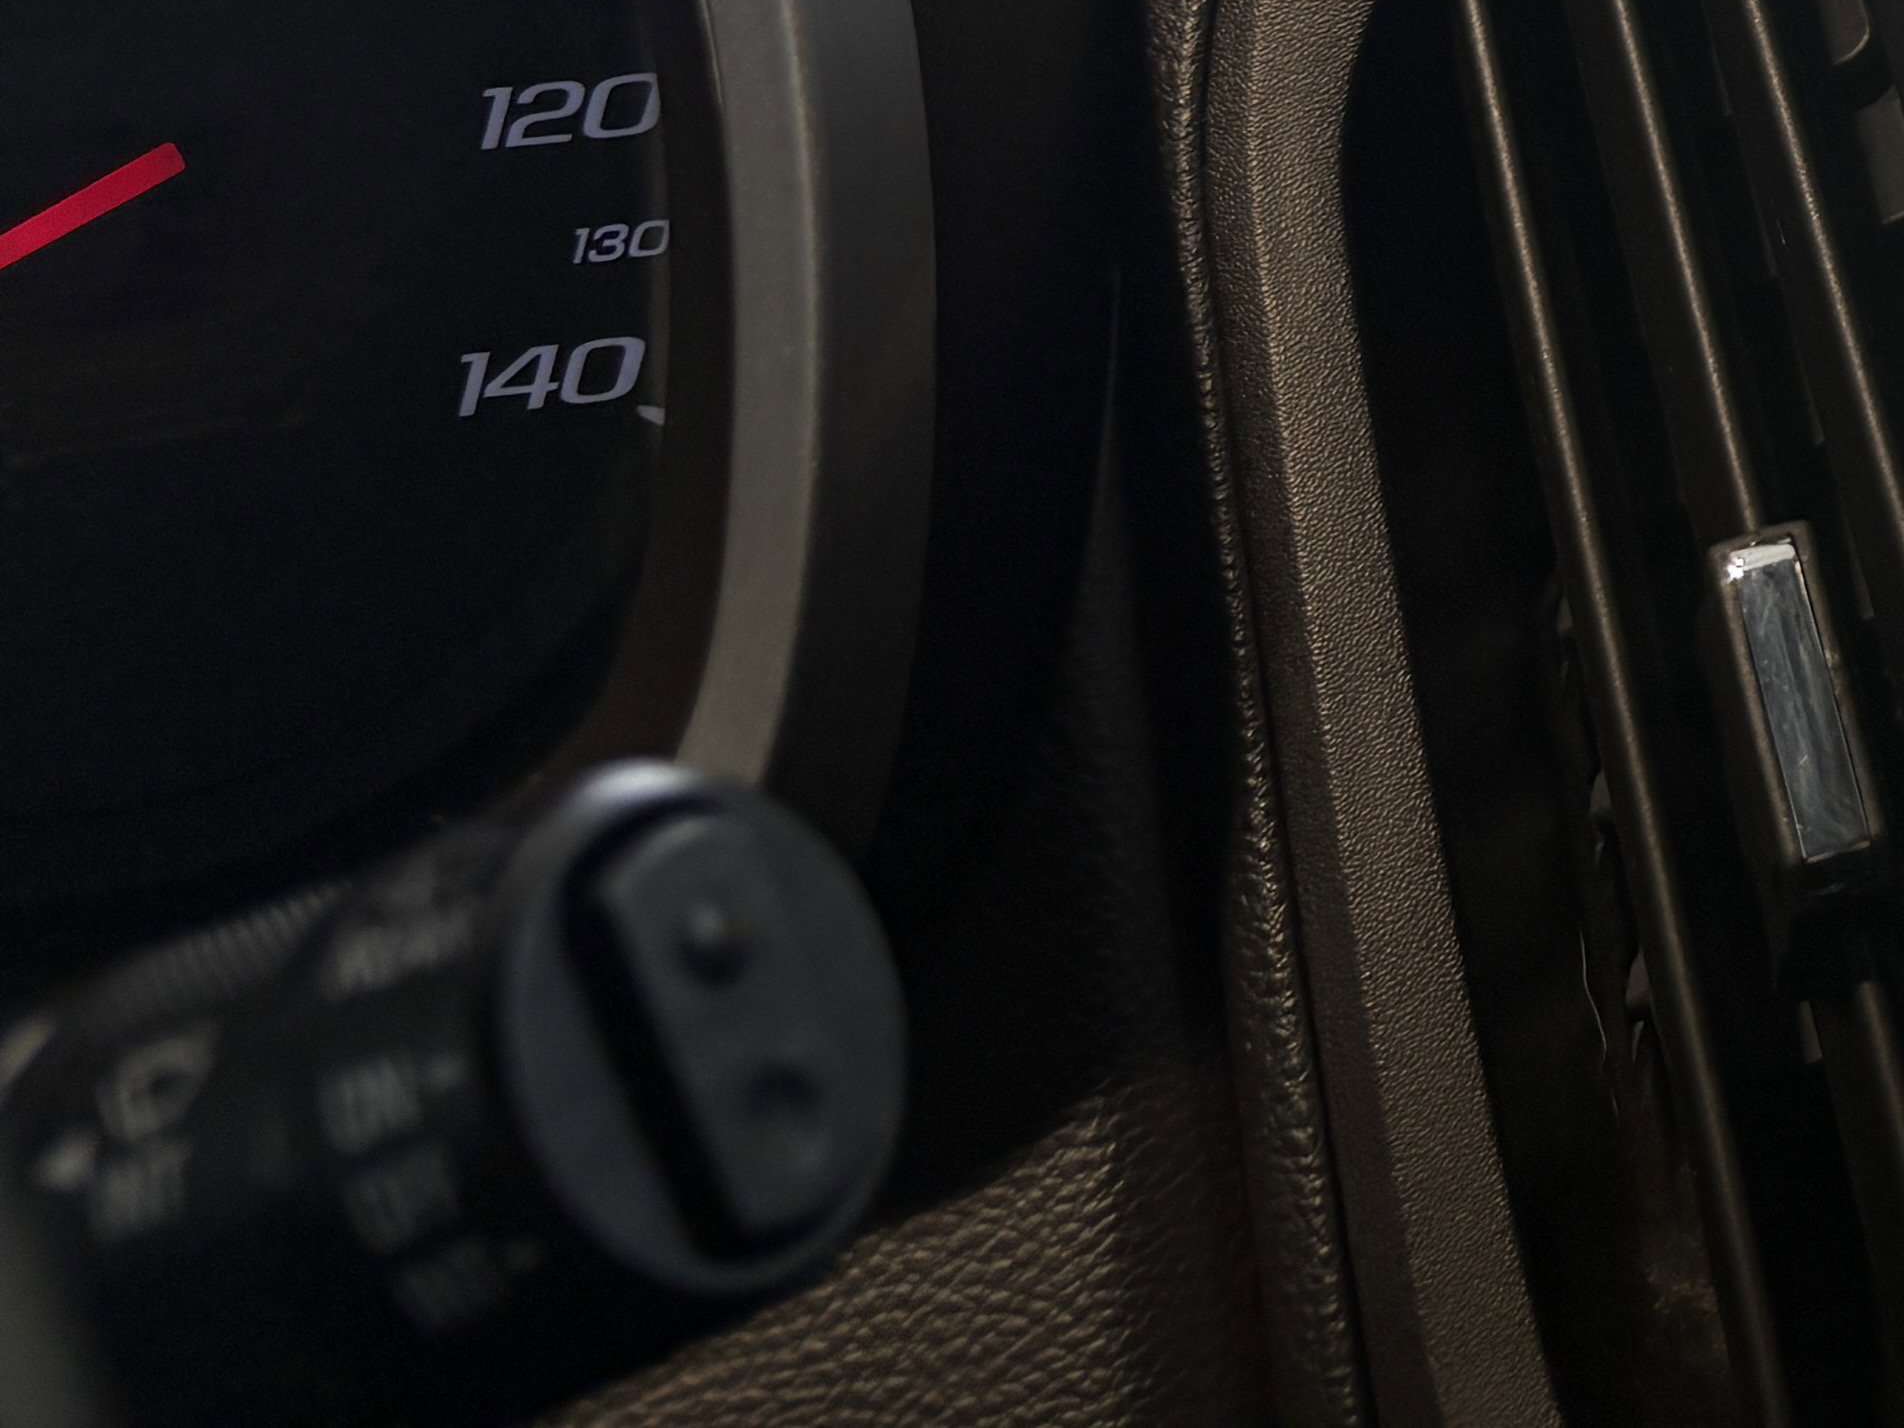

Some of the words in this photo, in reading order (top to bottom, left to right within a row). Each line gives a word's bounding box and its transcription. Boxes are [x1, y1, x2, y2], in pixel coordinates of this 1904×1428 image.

[479, 72, 661, 150] 120
[572, 218, 670, 264] 130
[457, 335, 645, 417] 140
